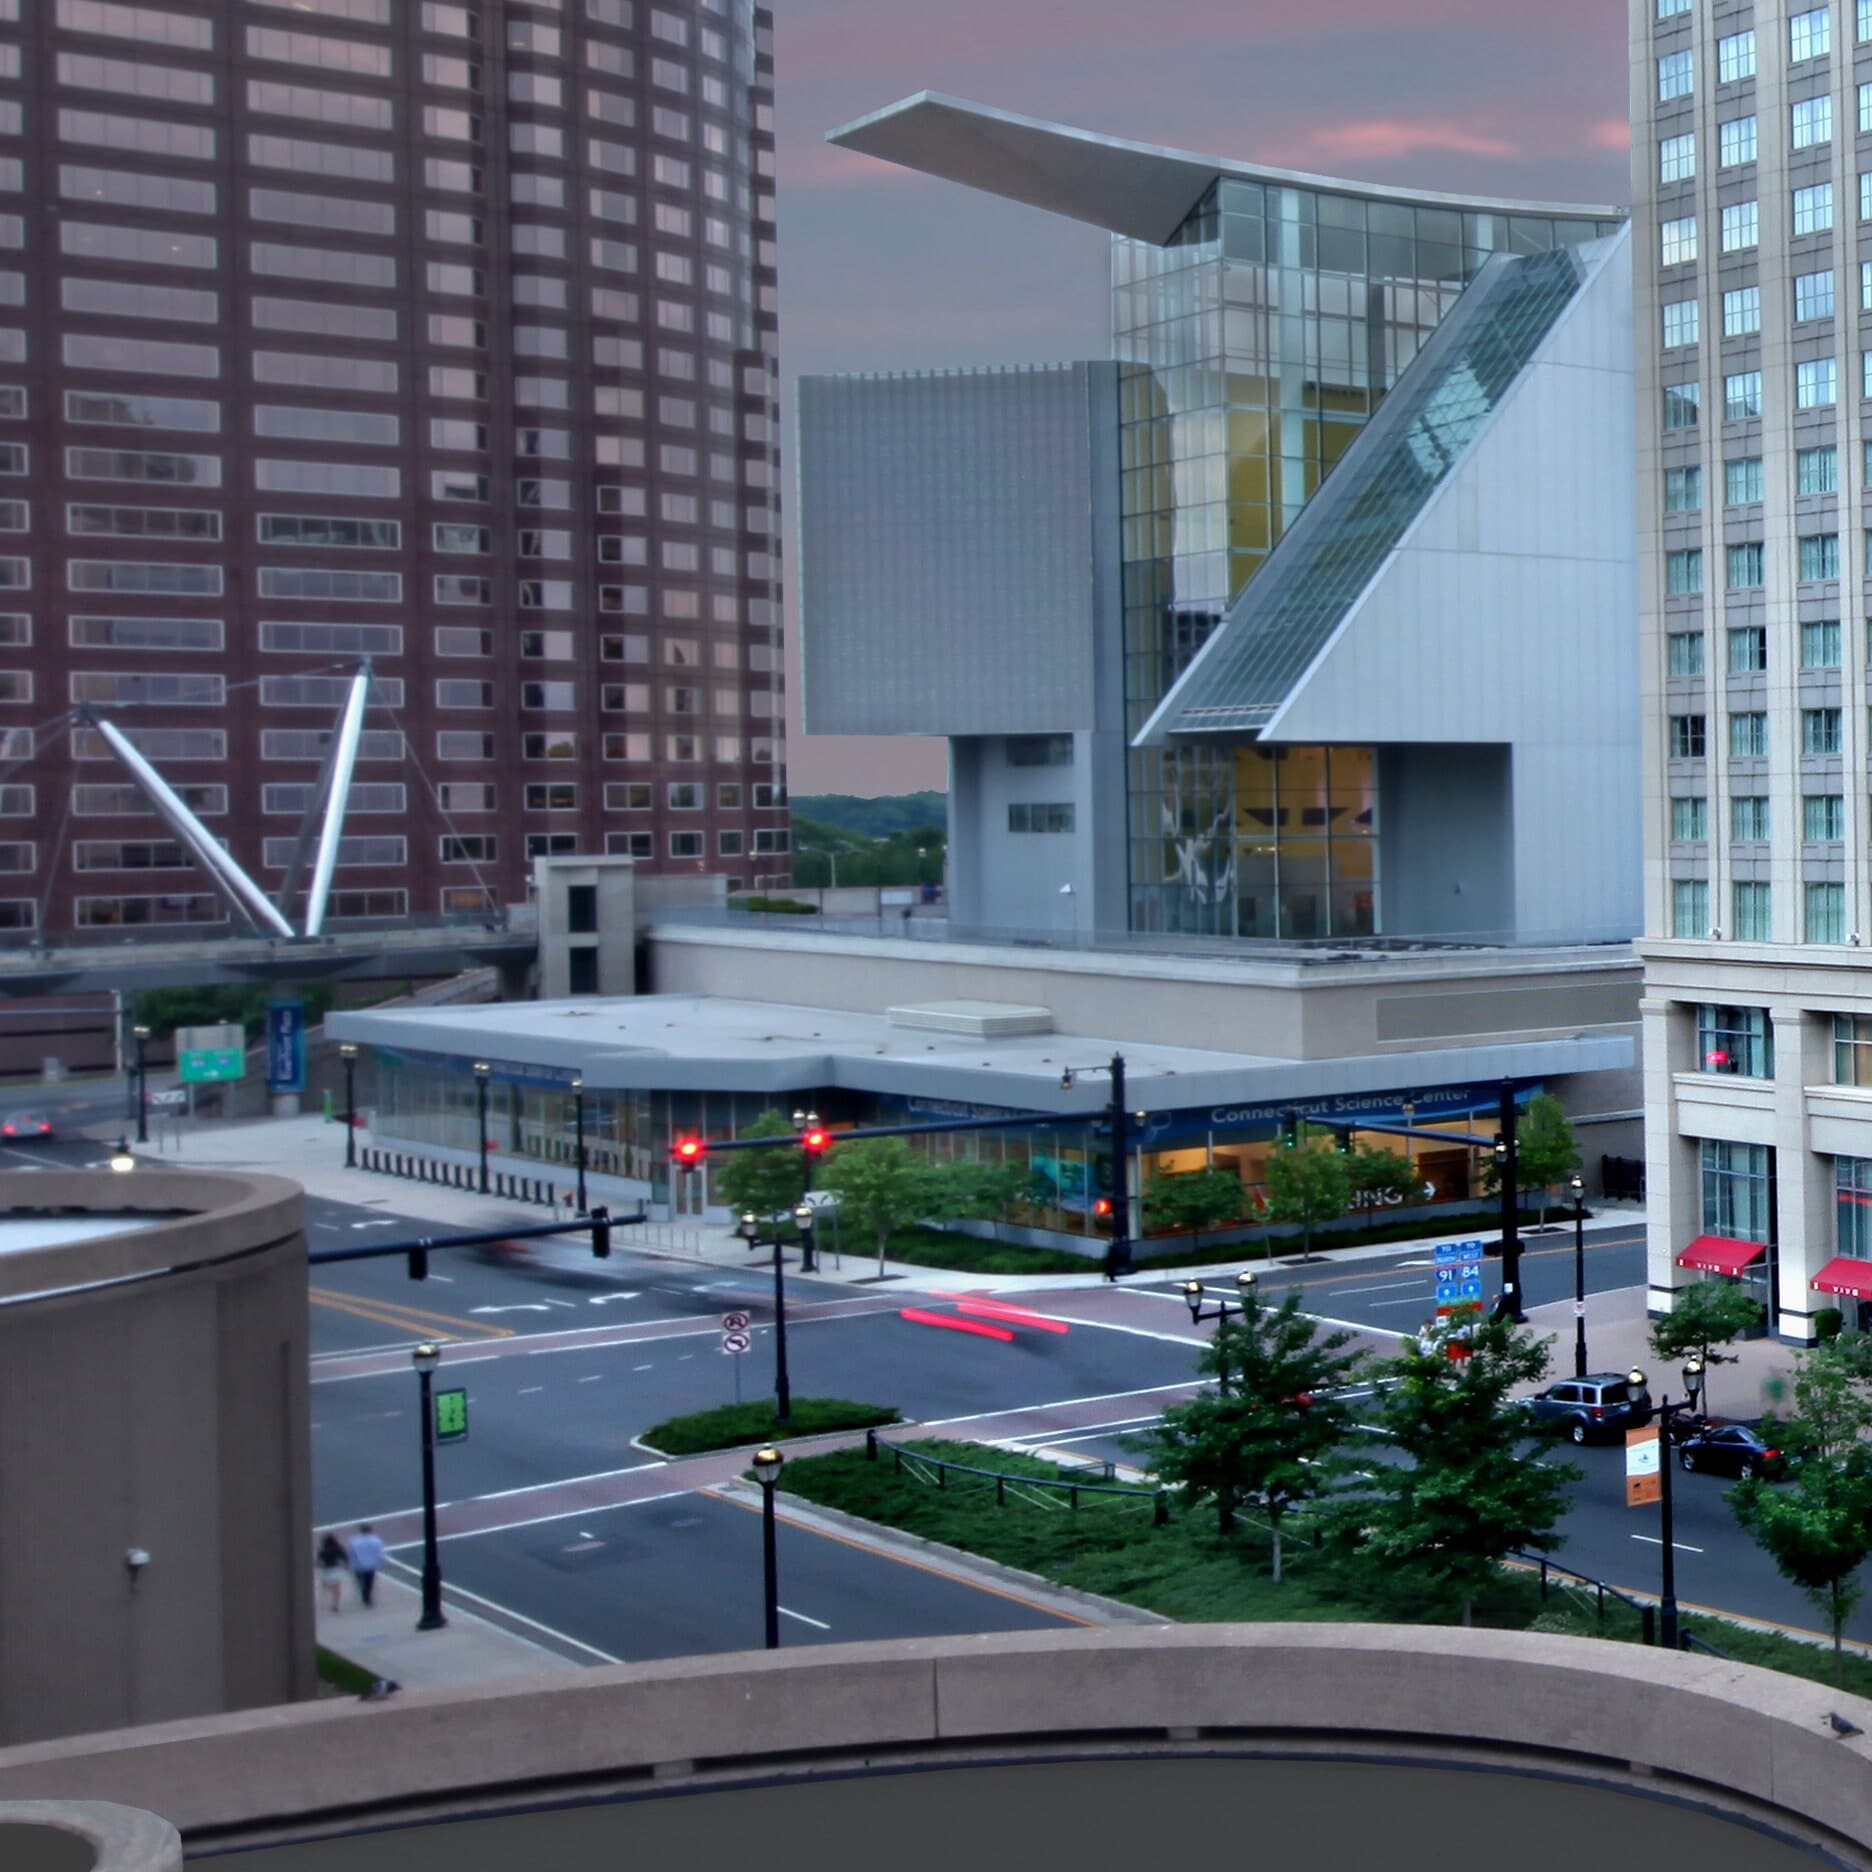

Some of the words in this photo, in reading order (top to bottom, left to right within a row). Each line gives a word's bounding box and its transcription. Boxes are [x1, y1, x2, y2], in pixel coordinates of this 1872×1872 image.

[1211, 1101, 1329, 1123] Conneccut
[1335, 1094, 1404, 1112] Science
[1439, 1270, 1453, 1283] 91
[1462, 1265, 1479, 1278] 84
